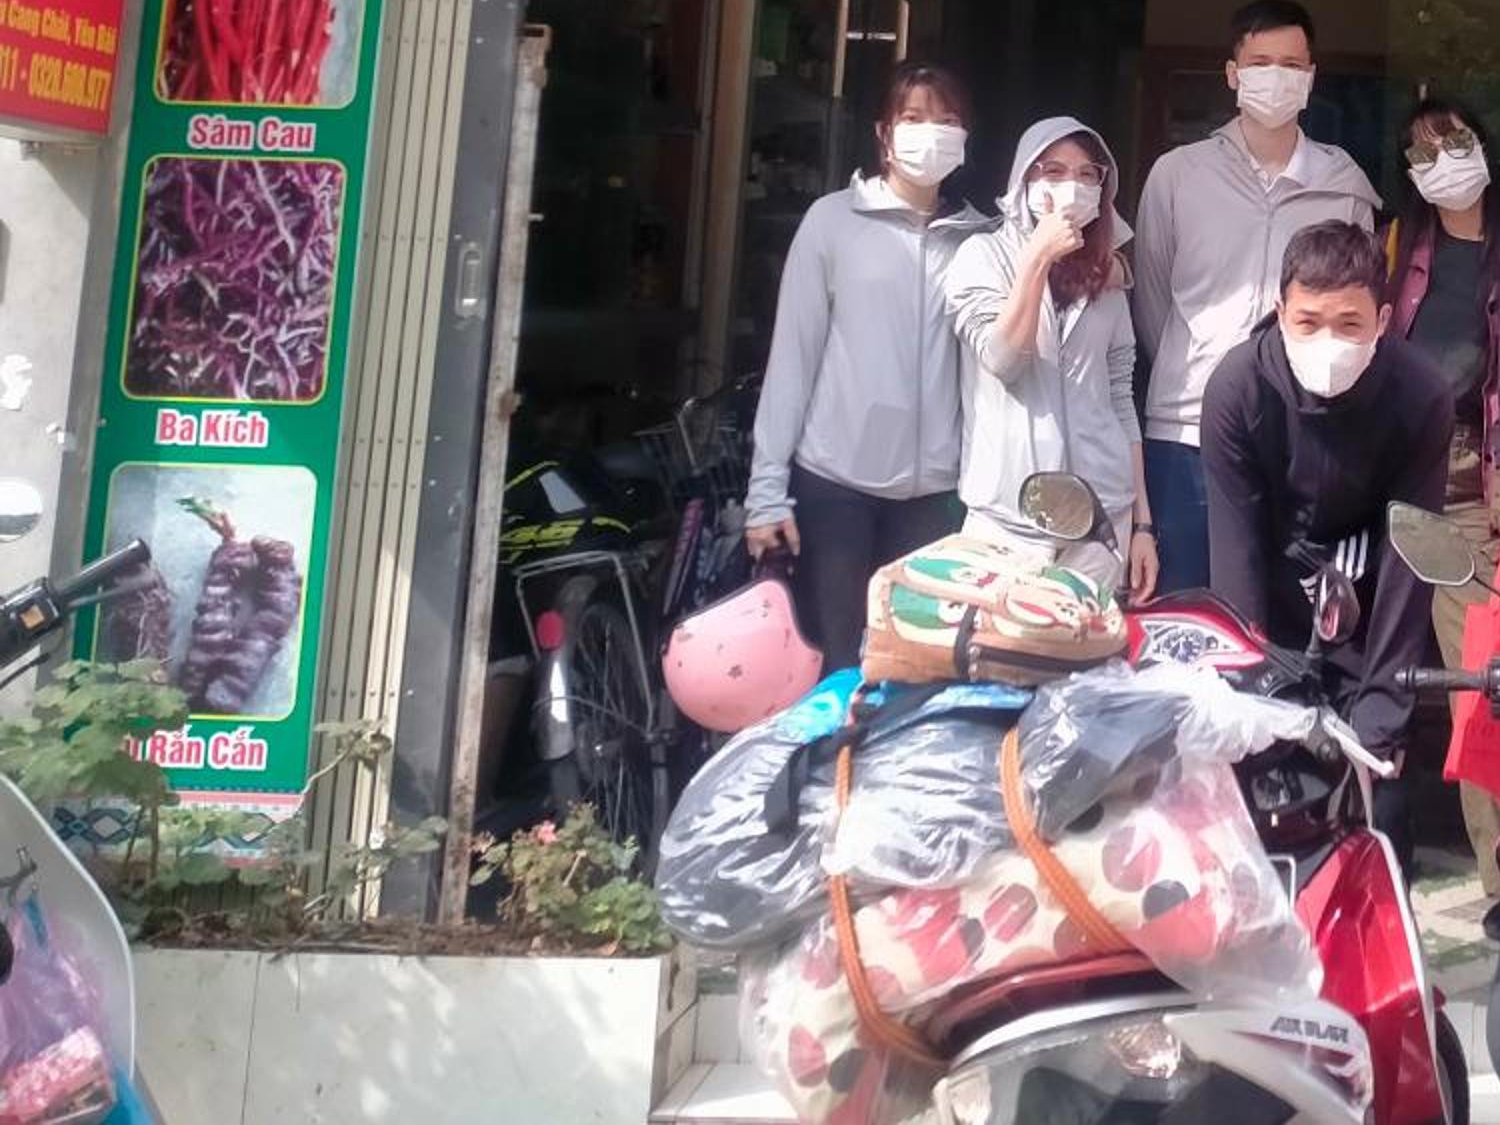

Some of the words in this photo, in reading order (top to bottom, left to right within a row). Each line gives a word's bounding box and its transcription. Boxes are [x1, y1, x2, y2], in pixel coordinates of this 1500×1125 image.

[187, 114, 255, 150] Sâm
[257, 116, 316, 151] Cau
[155, 408, 198, 445] Ba
